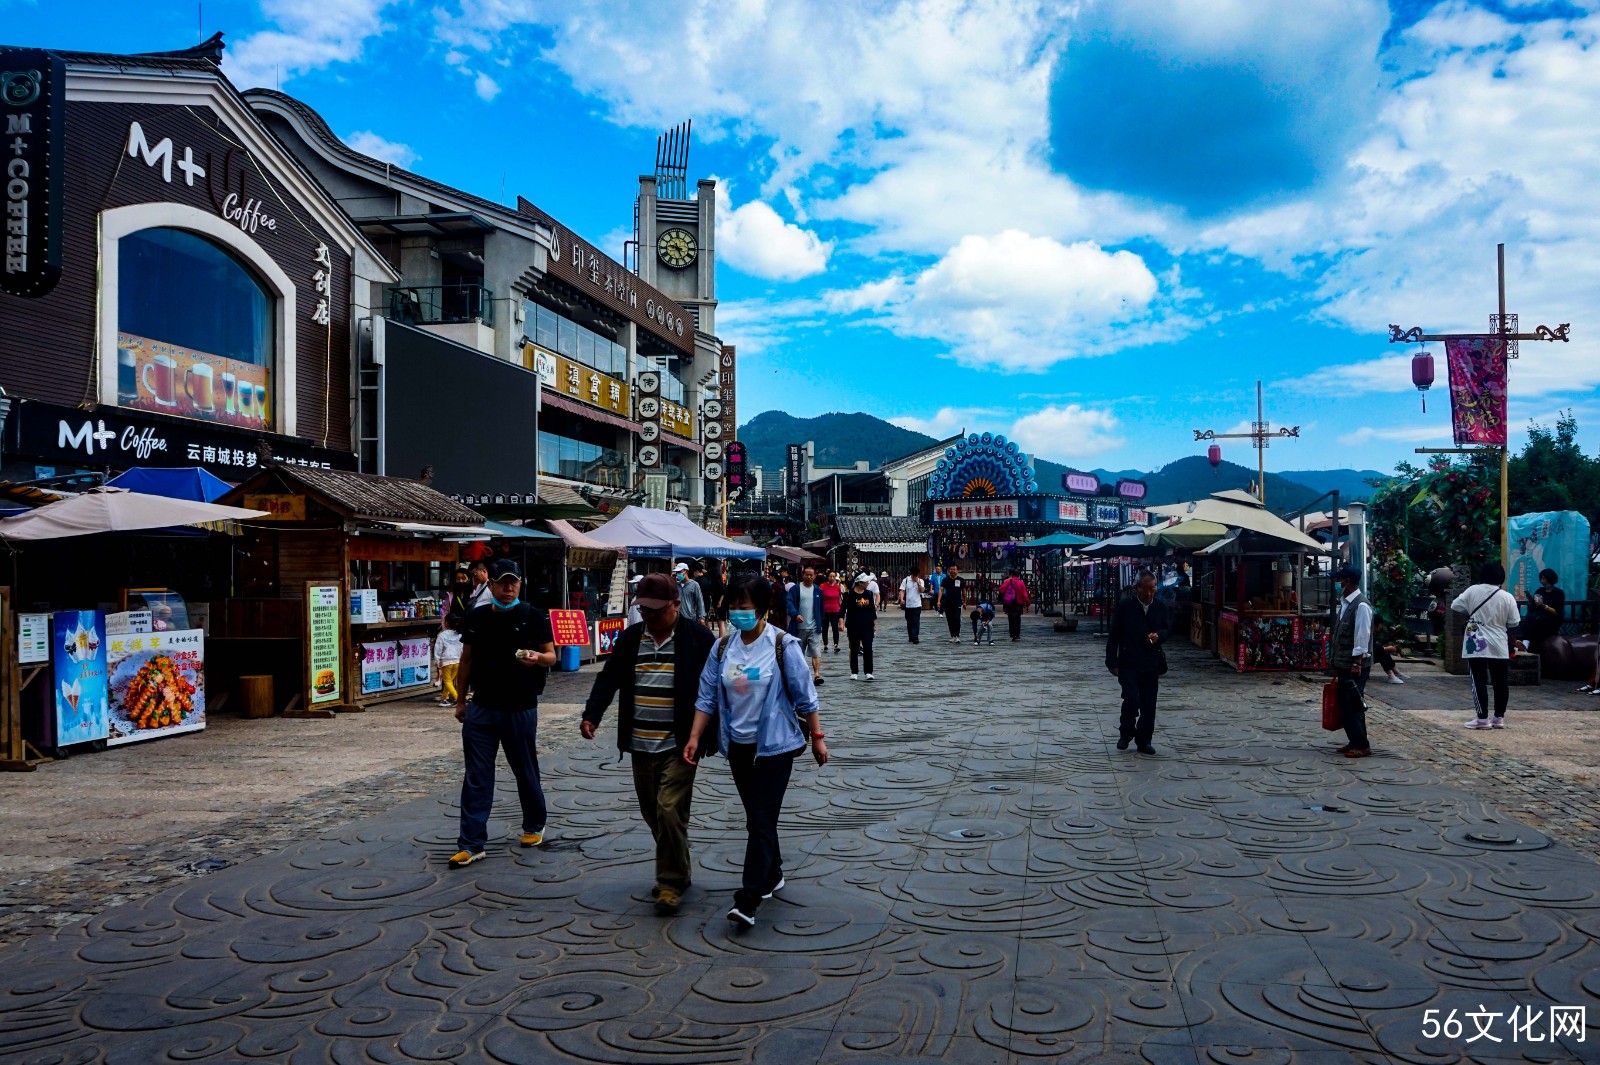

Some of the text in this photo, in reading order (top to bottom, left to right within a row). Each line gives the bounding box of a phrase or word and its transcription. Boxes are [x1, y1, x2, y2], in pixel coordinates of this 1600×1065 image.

[129, 121, 206, 186] M+
[222, 193, 278, 234] Coffee
[58, 419, 168, 459] M+ Coffee
[642, 378, 656, 462] 传统美食
